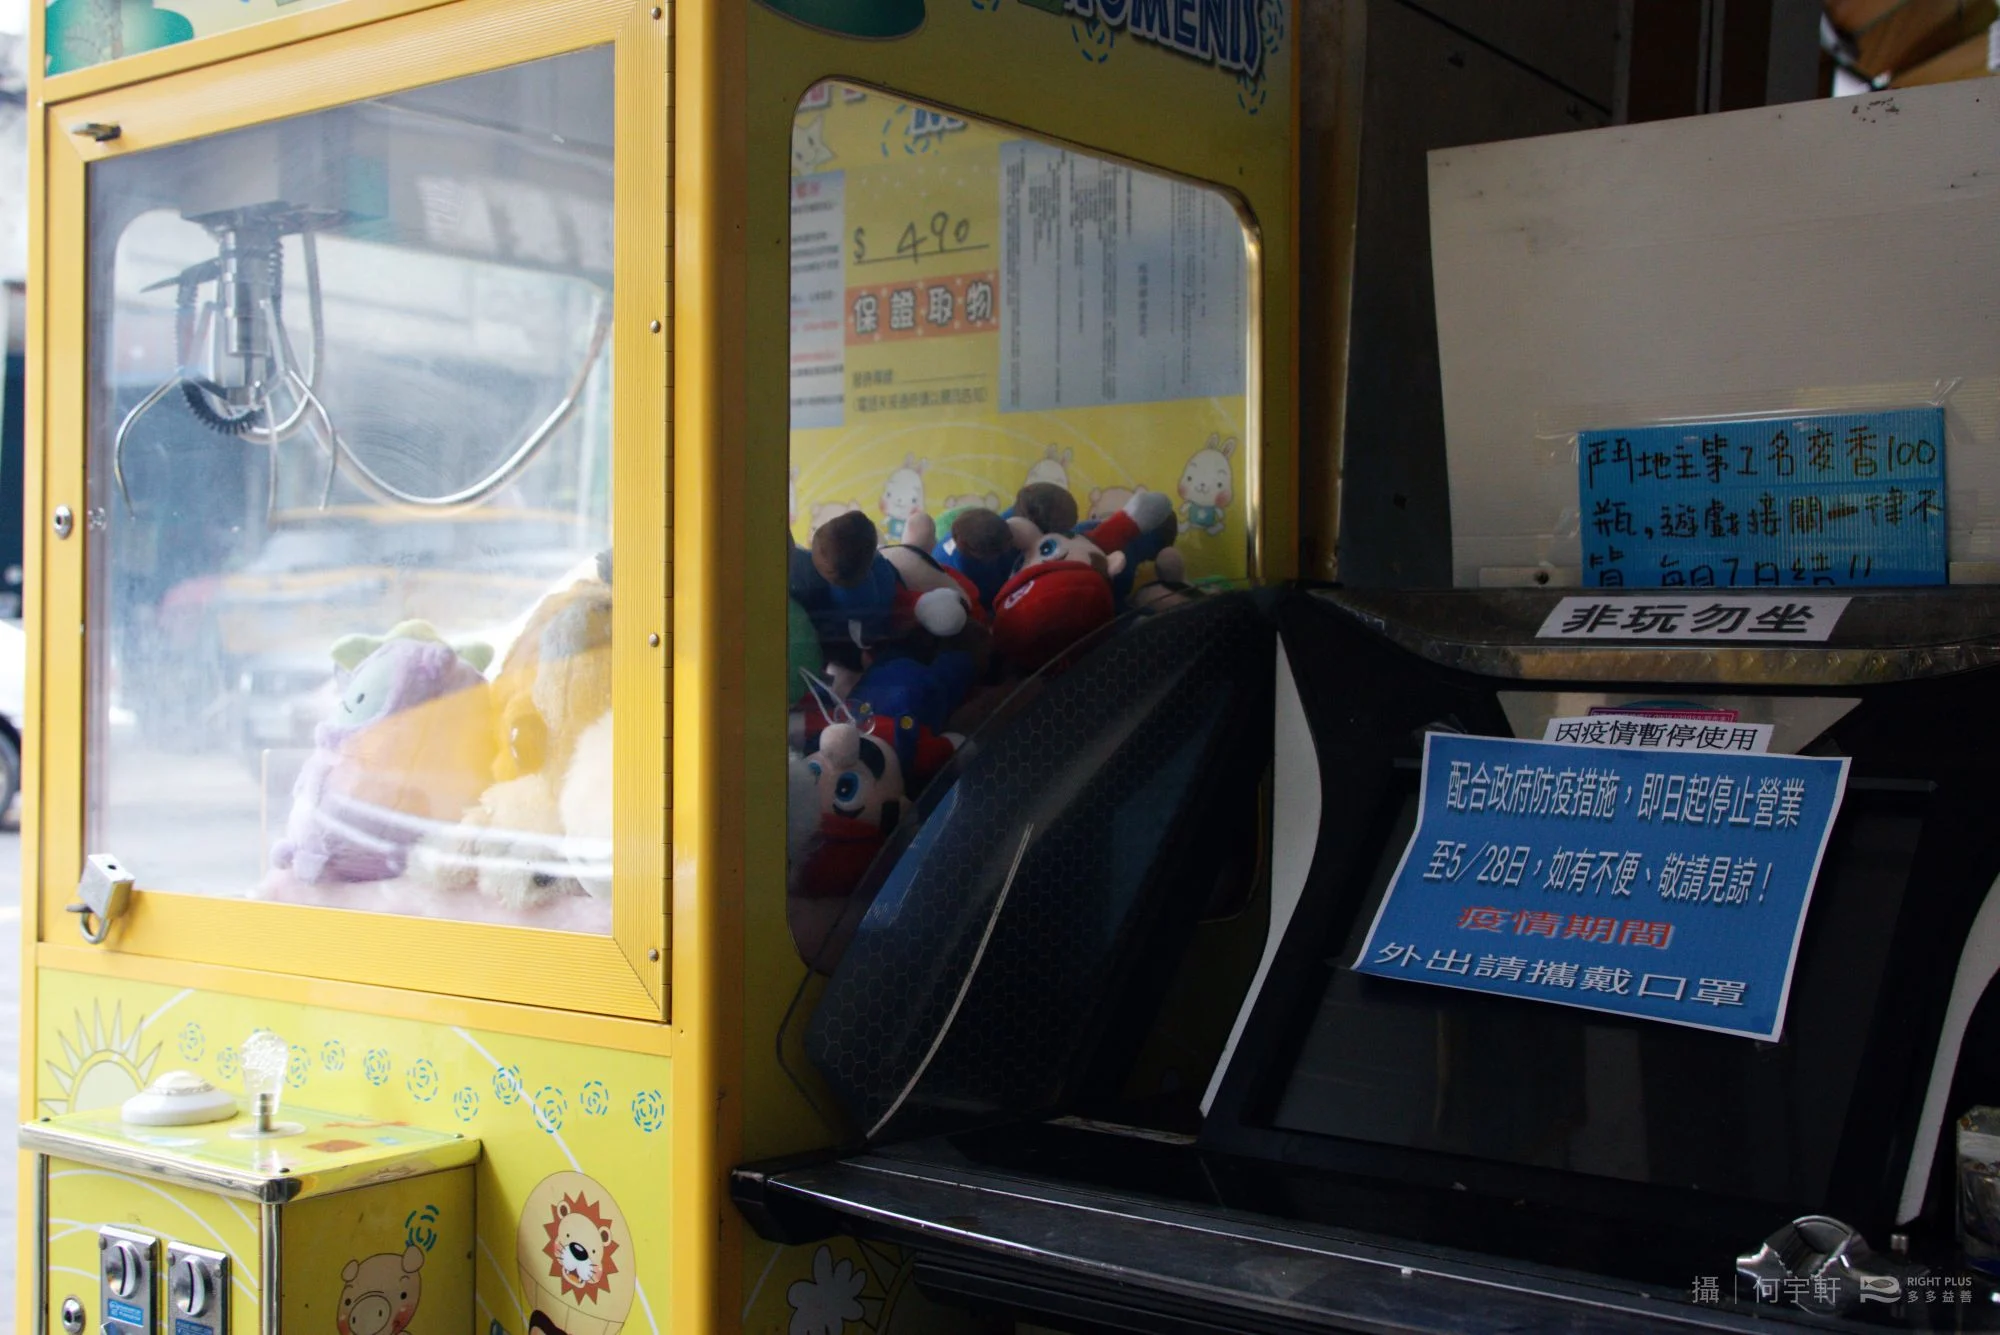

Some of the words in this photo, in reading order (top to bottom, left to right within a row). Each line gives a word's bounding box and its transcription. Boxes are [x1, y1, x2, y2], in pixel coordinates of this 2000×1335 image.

[853, 226, 866, 262] $
[896, 211, 970, 265] 490
[854, 280, 994, 334] 保證取物
[1561, 602, 1815, 634] 非玩勿坐
[1554, 720, 1759, 751] 因疫情暫停使用
[1445, 760, 1805, 829] 配合政府防疫措施，即日起停止營業
[1456, 905, 1676, 950] 疫情期間
[1373, 941, 1749, 1008] 外出請攜戴口罩
